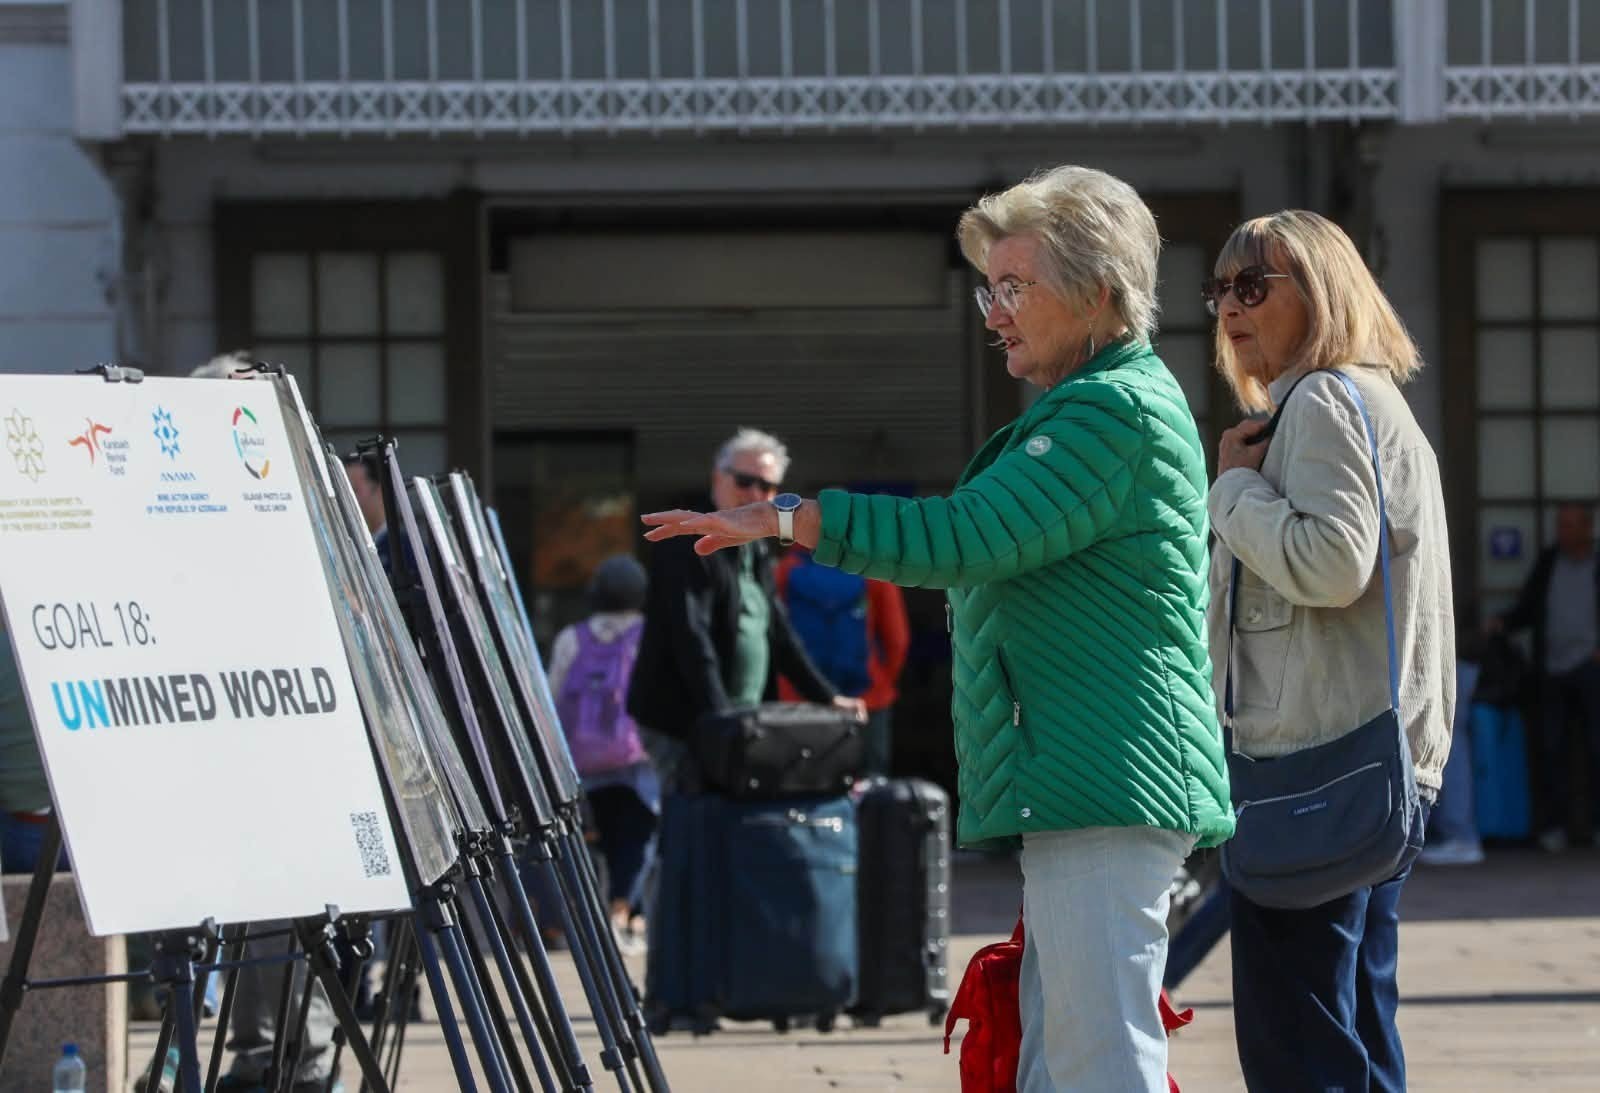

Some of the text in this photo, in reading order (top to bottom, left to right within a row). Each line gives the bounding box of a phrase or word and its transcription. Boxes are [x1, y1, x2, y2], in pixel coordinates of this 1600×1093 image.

[160, 472, 196, 481] ANAMA
[32, 601, 157, 650] GOAL 18:
[51, 667, 337, 731] UNMINED WORLD
